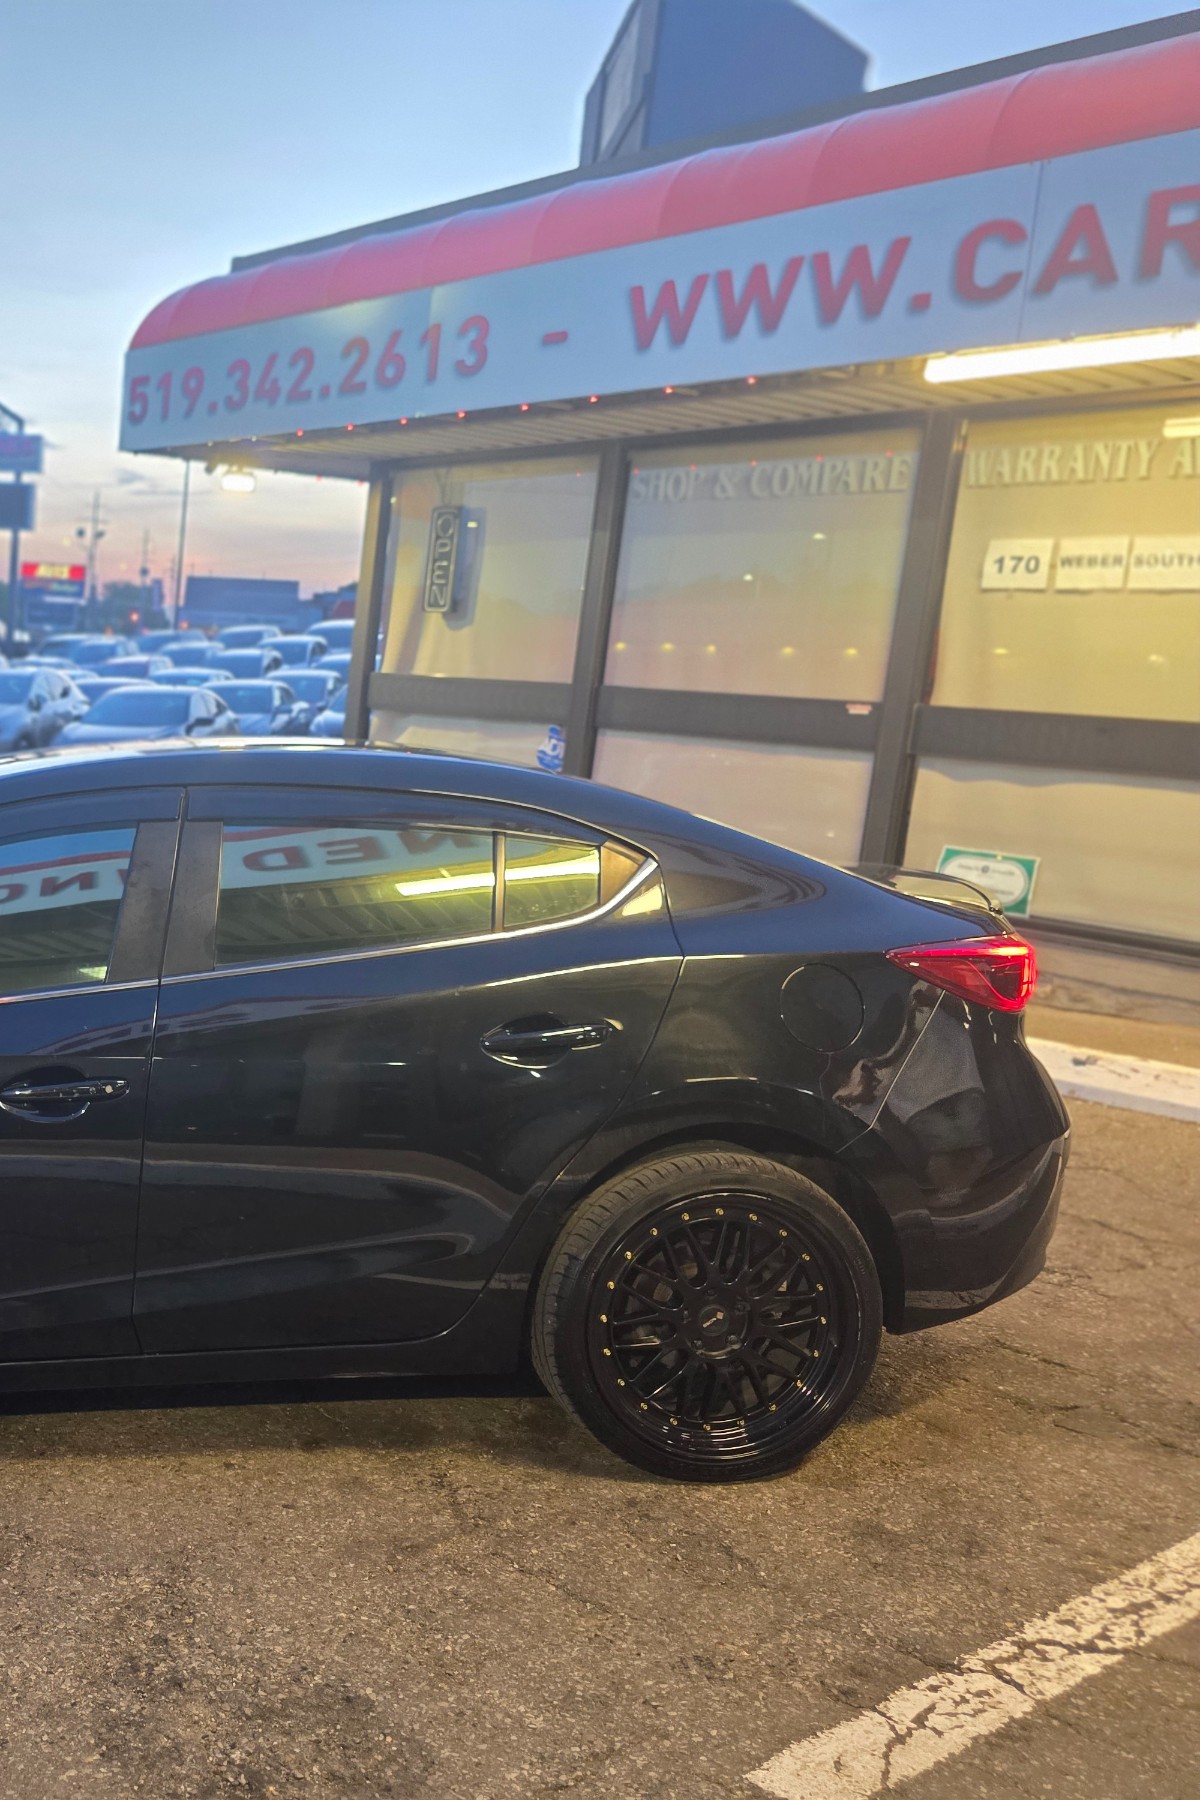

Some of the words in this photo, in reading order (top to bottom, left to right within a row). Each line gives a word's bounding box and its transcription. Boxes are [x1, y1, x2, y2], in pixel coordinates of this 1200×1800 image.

[126, 314, 490, 425] 519.342.2613
[630, 184, 1200, 352] WWW.CAR
[632, 470, 704, 501] SHOP
[749, 455, 913, 498] COMPARE
[965, 439, 1161, 487] WARRANTY
[430, 515, 455, 606] OPEN
[993, 555, 1041, 574] 170
[1060, 554, 1124, 568] WEBER
